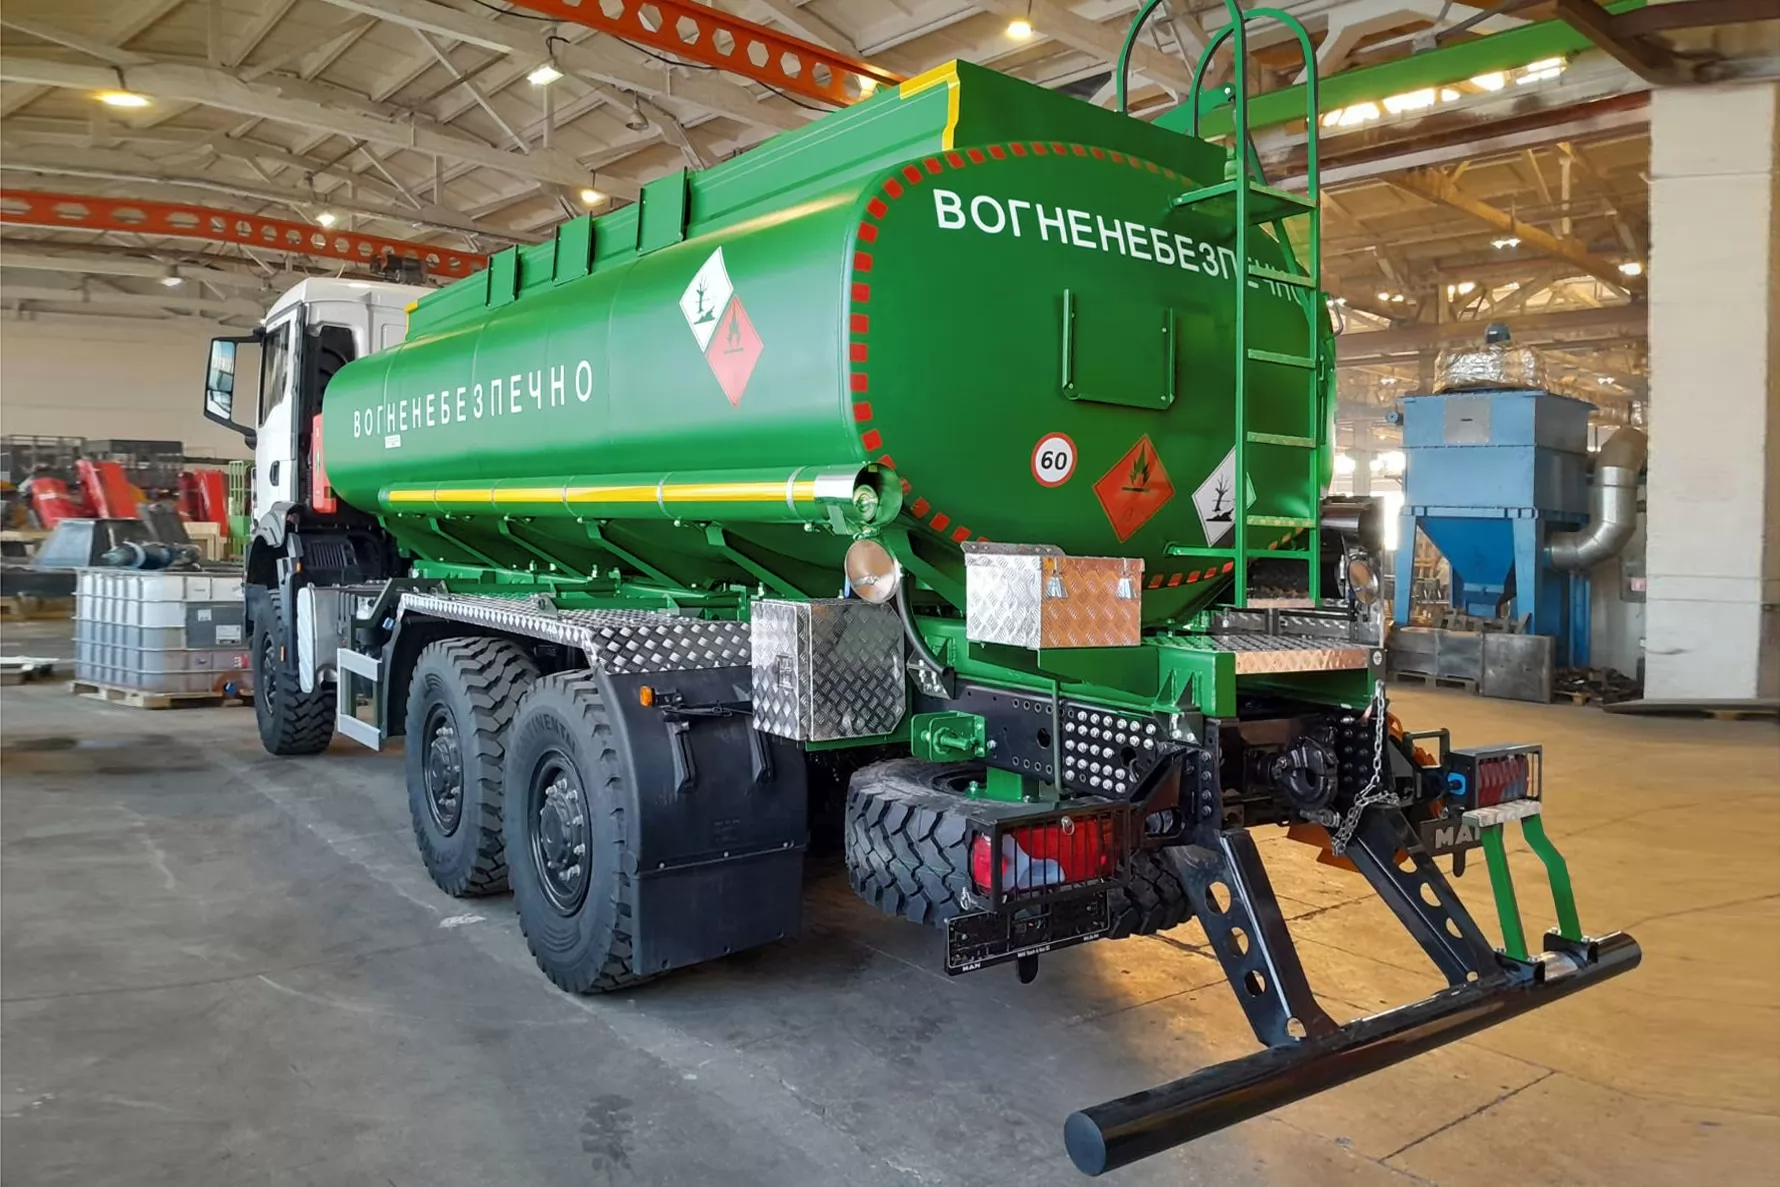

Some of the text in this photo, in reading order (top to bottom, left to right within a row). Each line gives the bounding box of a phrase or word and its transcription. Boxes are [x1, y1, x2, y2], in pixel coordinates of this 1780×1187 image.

[353, 360, 593, 438] ВОГНЕНЕБЕЗПЕЧНО
[1040, 451, 1068, 470] 60
[962, 962, 981, 972] MAN
